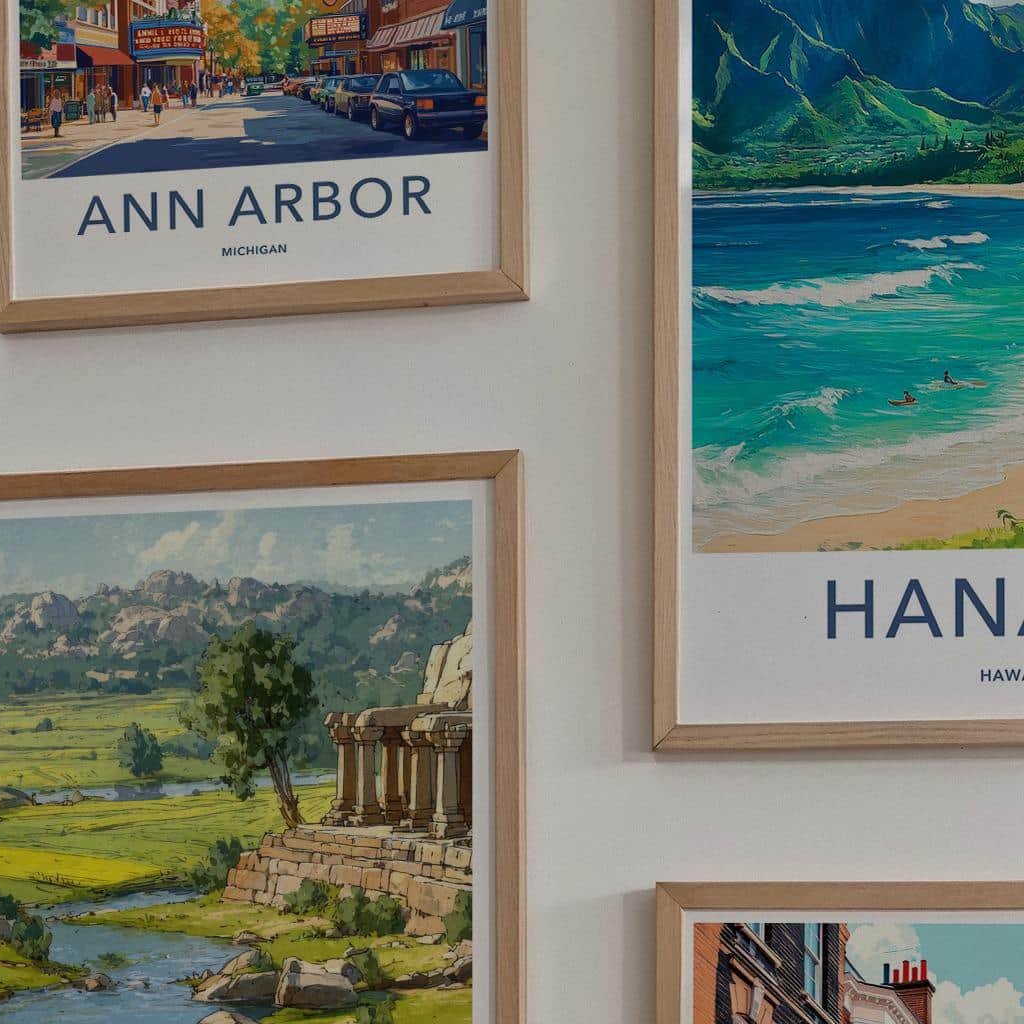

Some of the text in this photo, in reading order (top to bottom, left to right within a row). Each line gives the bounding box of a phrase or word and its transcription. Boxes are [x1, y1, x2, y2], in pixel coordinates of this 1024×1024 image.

[77, 175, 432, 236] ANN ARBOR
[221, 244, 288, 257] MICHIGAN
[826, 577, 1024, 640] HAN
[980, 668, 1024, 682] HAW
